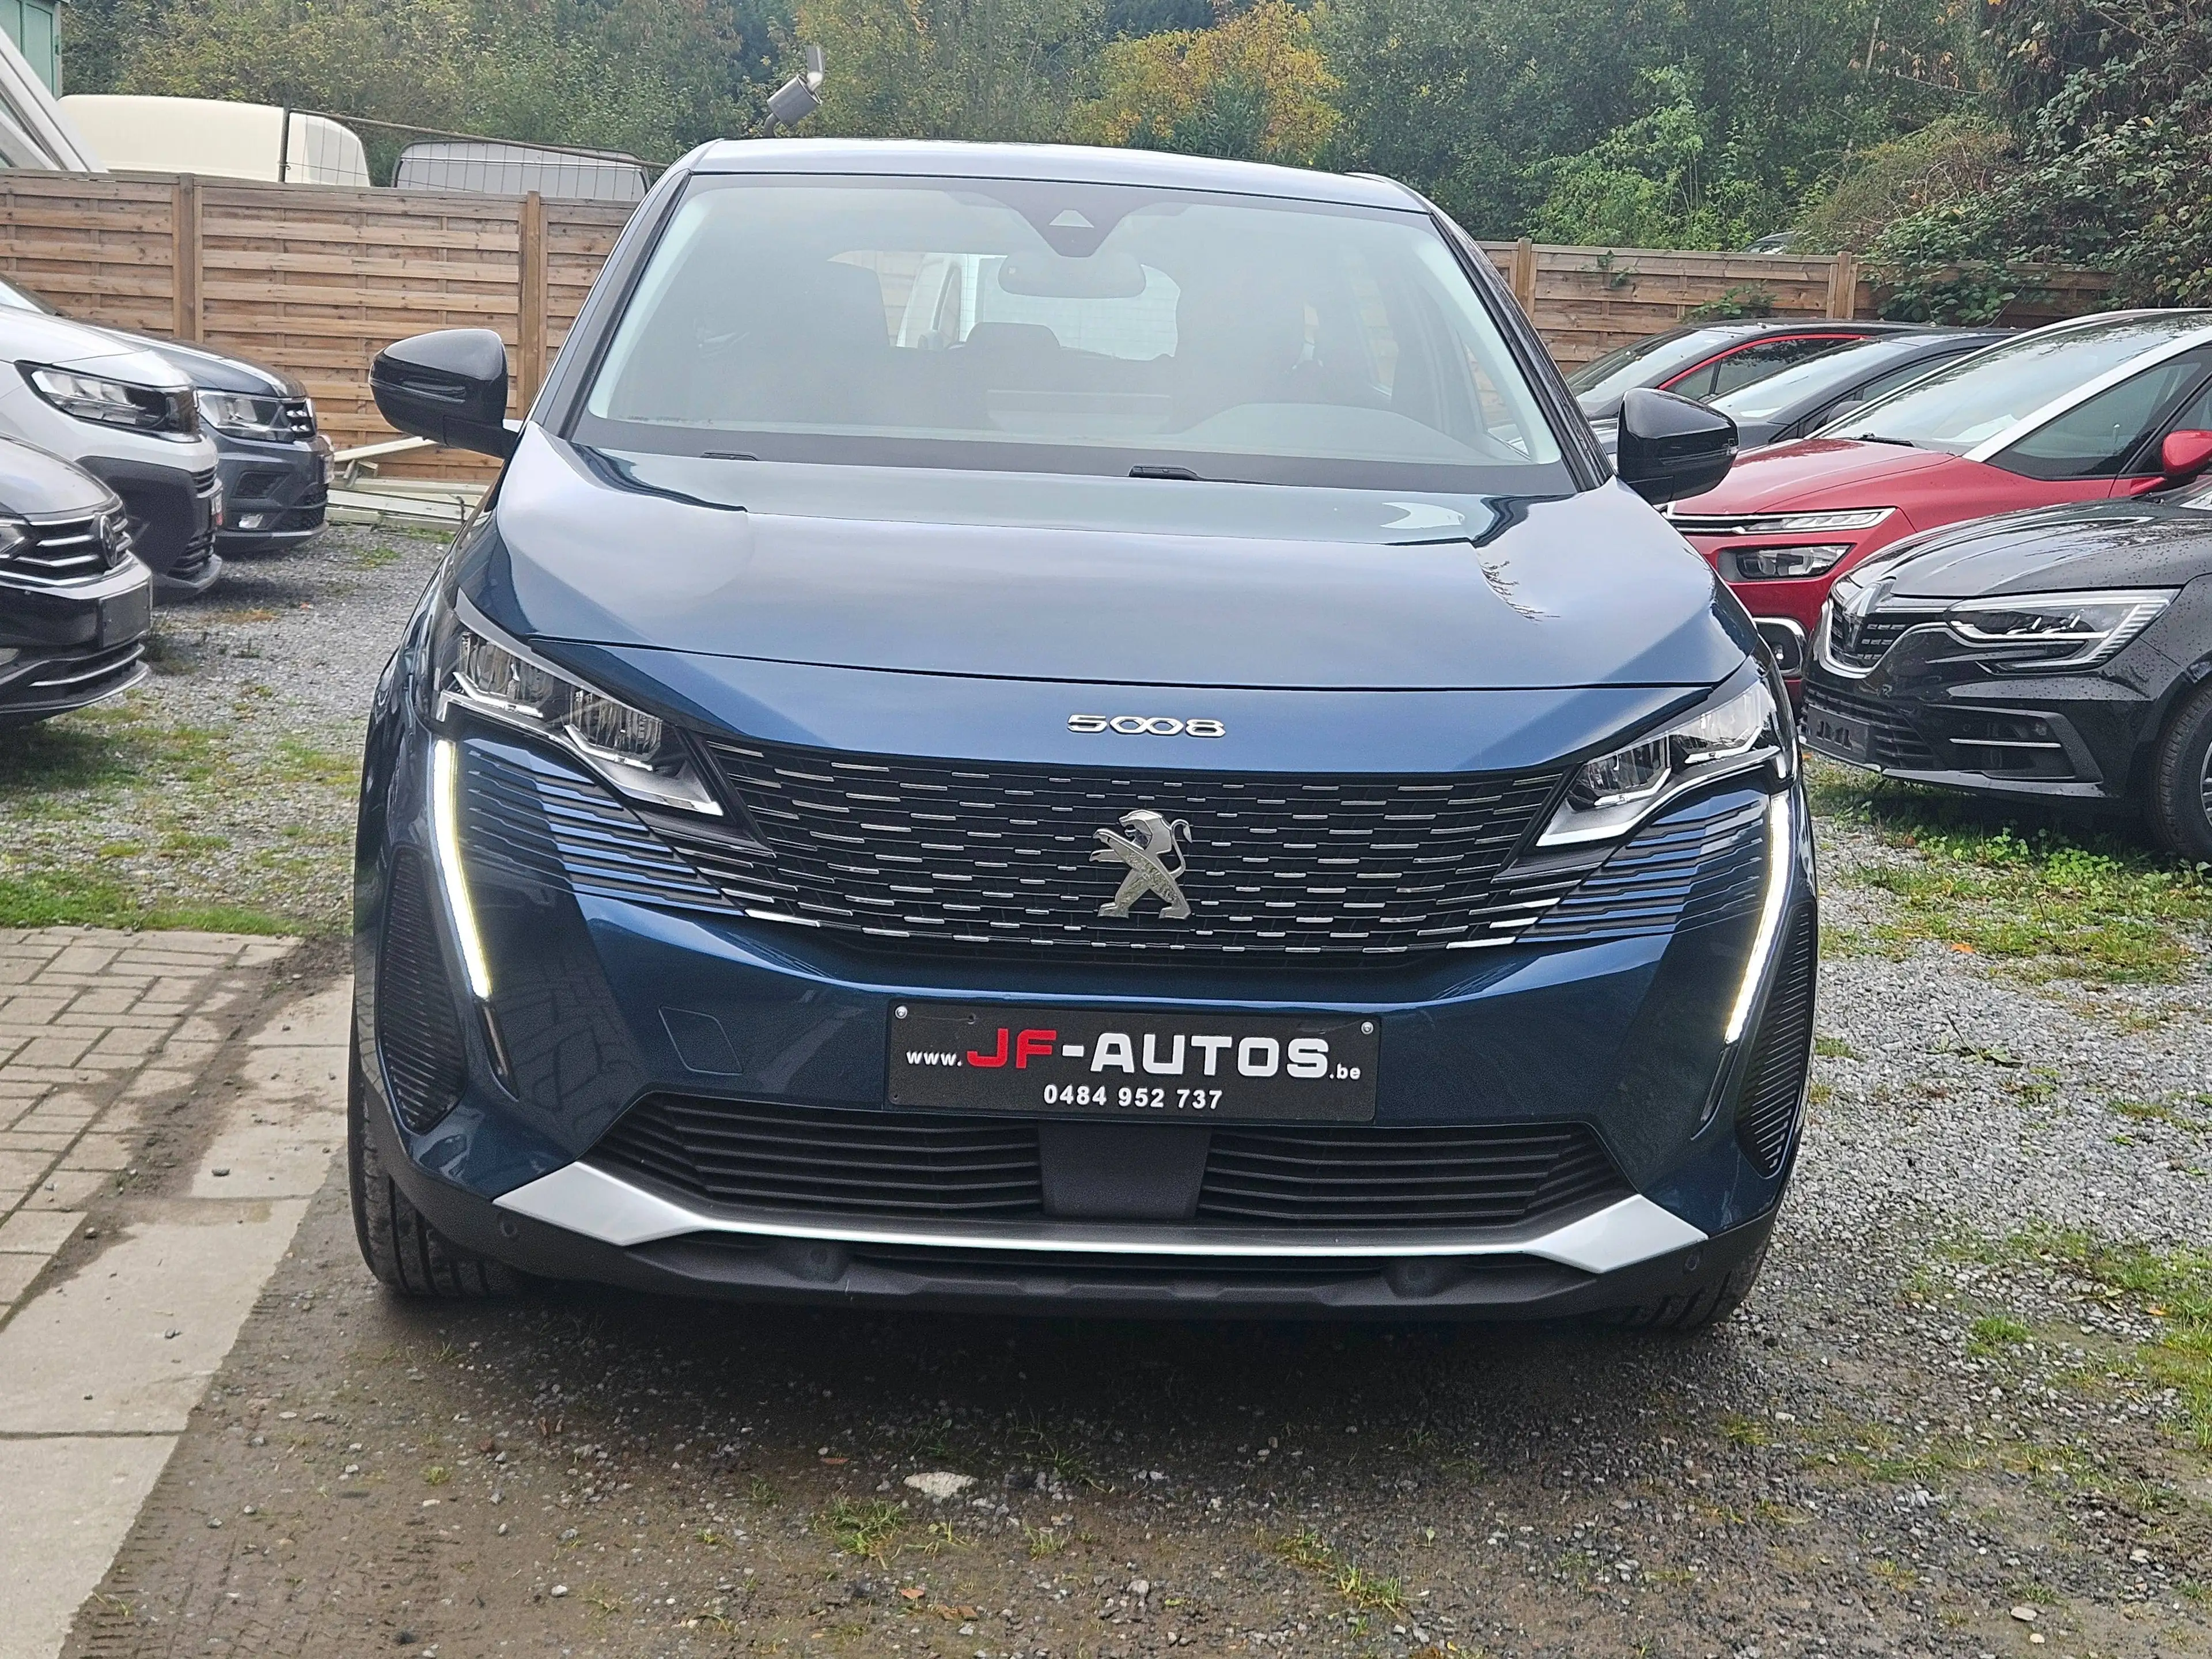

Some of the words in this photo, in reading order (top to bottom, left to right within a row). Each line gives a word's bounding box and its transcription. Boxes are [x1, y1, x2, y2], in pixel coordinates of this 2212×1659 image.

[1067, 714, 1226, 738] 5008
[1043, 1084, 1107, 1106] 0484
[1118, 1086, 1165, 1108] 952
[1176, 1089, 1223, 1109] 737
